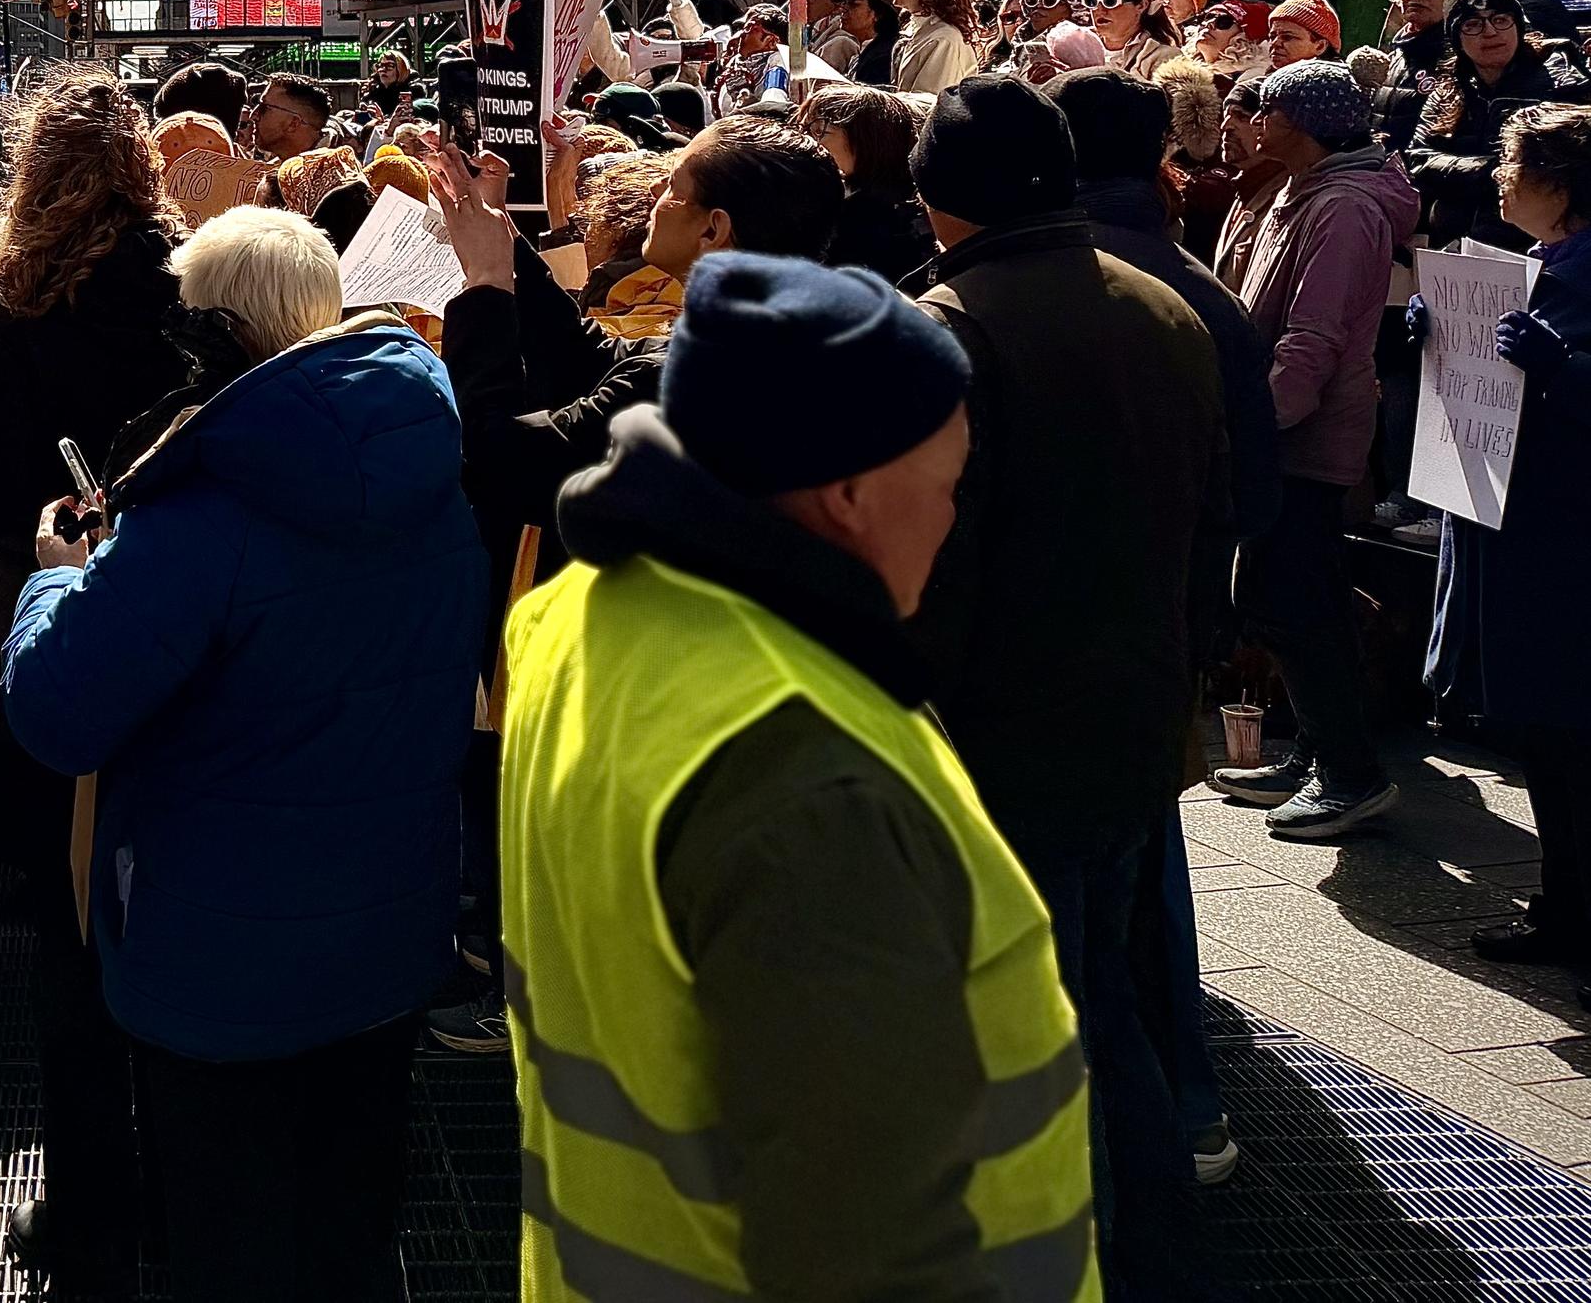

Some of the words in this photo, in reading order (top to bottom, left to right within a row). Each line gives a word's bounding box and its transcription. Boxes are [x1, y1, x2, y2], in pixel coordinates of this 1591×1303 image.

[485, 68, 532, 88] KINGS.
[484, 97, 534, 116] TRUMP
[481, 126, 538, 145] KEOVER.
[167, 166, 213, 202] NO
[1433, 274, 1459, 312] NO
[1435, 318, 1461, 352] NO
[1440, 413, 1458, 445] IN
[1465, 418, 1515, 458] LIVES
